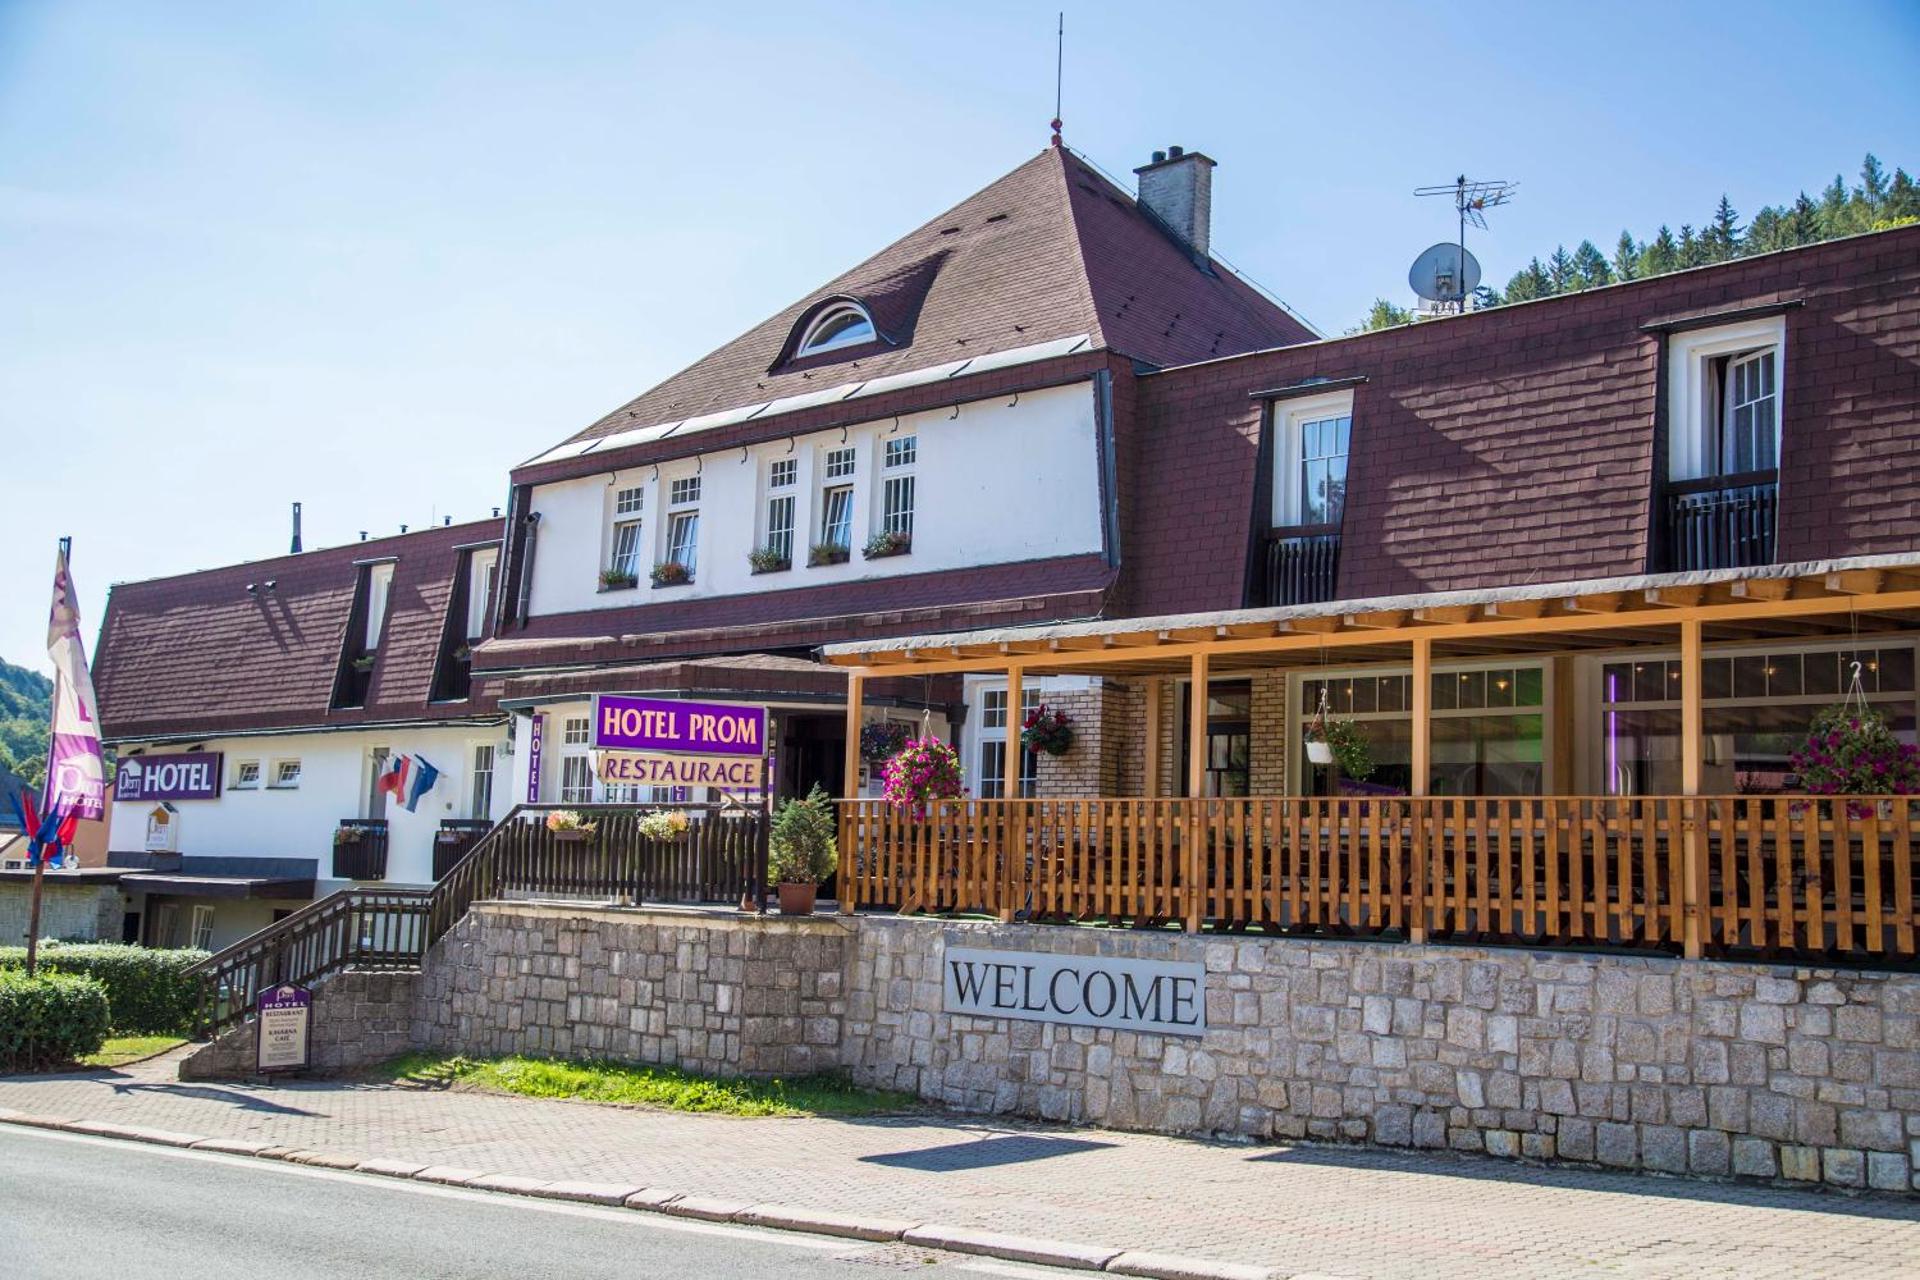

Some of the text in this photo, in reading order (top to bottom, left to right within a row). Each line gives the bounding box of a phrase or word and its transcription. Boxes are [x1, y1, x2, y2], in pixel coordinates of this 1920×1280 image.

[603, 707, 681, 740] HOTEL
[688, 713, 758, 745] PROM
[144, 763, 212, 792] HOTEL
[530, 722, 541, 801] HOTEL
[604, 758, 756, 784] RESTAURACE
[264, 1001, 307, 1009] HOTEL
[949, 960, 1200, 1026] WELCOME
